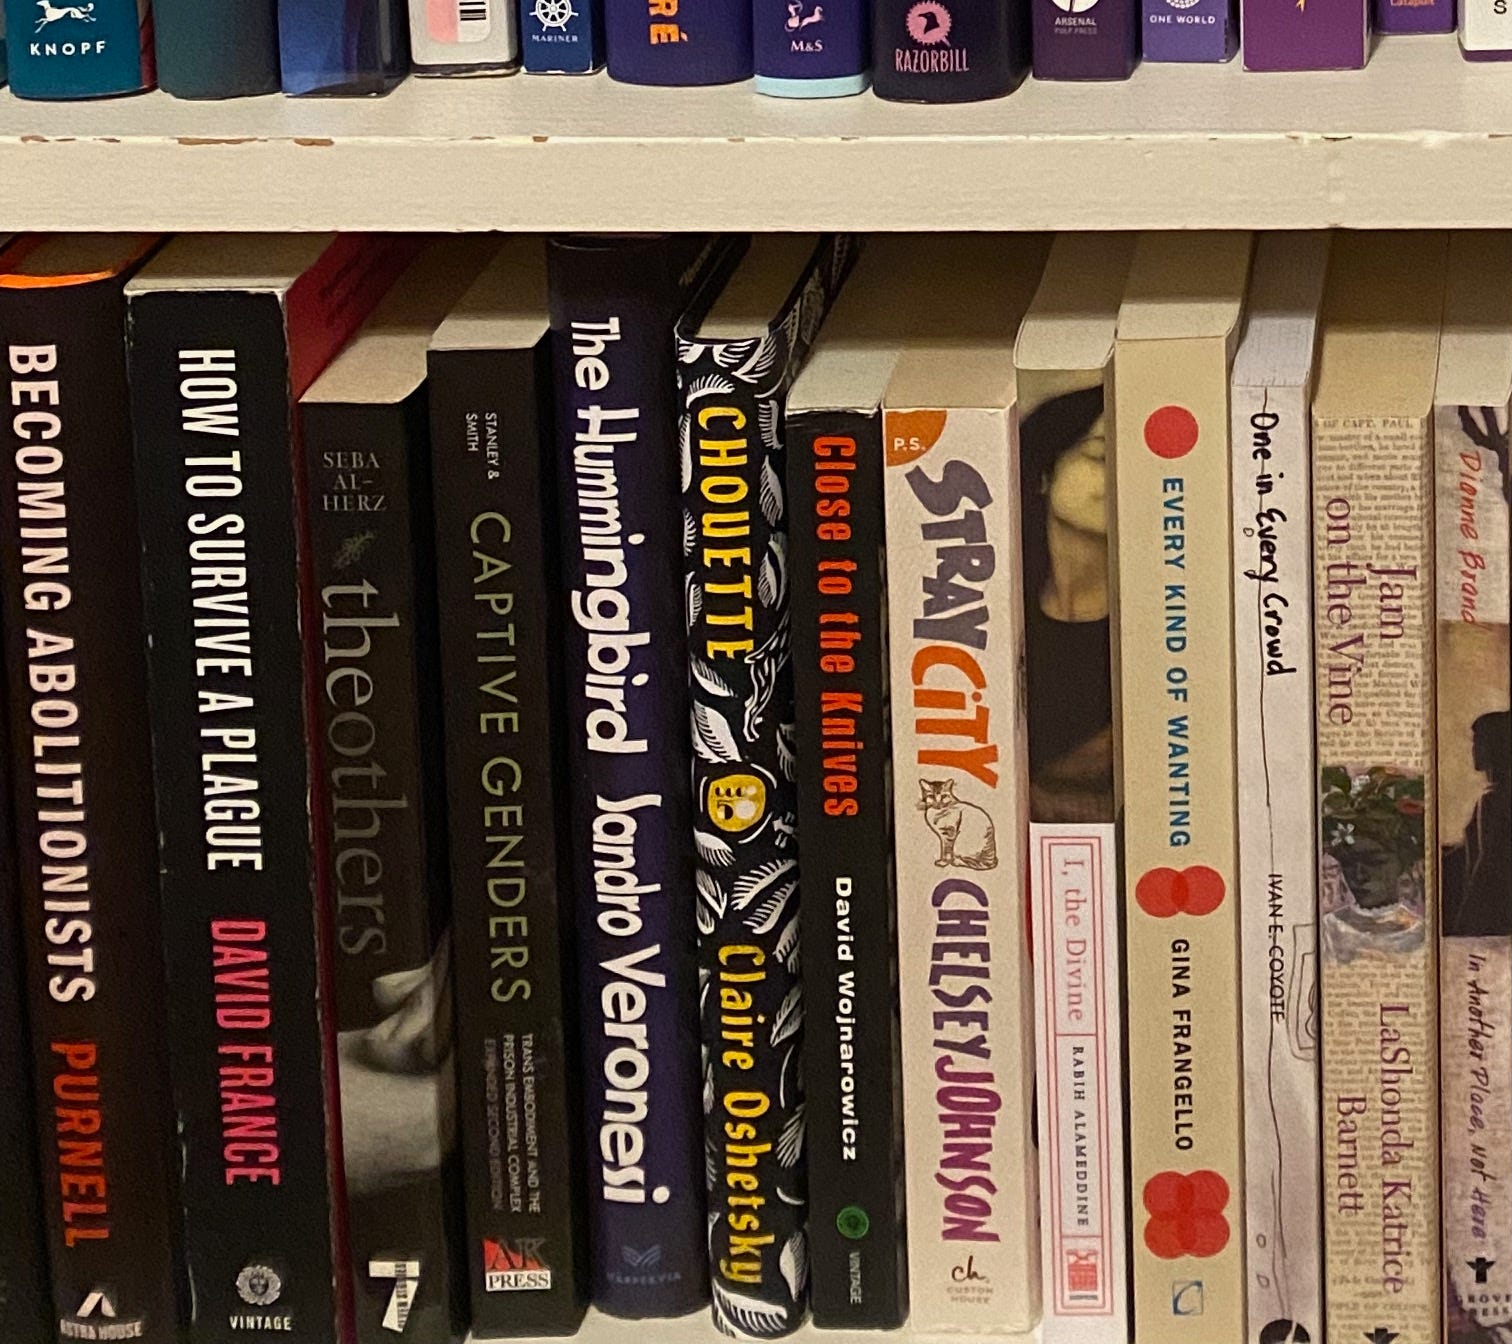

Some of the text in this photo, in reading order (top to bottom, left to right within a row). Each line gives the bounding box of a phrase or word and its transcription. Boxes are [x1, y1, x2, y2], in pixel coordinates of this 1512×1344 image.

[30, 41, 106, 56] KNOPF
[895, 49, 969, 72] RAZORBILL
[1150, 16, 1215, 24] ONE WORLD
[323, 452, 379, 469] SEBA
[323, 495, 387, 512] HERZ
[697, 406, 756, 660] CHOUETTE
[470, 512, 531, 1003] CAPTIVE GENDERS
[592, 794, 662, 937] Sandro
[835, 876, 860, 1161] David Wojnarowicz
[928, 878, 993, 1060] CHELSEY
[1171, 938, 1193, 1151] GINA FRANGELLO
[50, 1042, 110, 1247] PURNELL
[599, 943, 670, 1204] Veronesi
[1072, 1046, 1089, 1227] RABIH ALAMEDDINE
[1336, 1095, 1367, 1214] Barnett
[1378, 1003, 1415, 1294] LaShonda Katrice
[230, 1316, 291, 1331] VINTAGE
